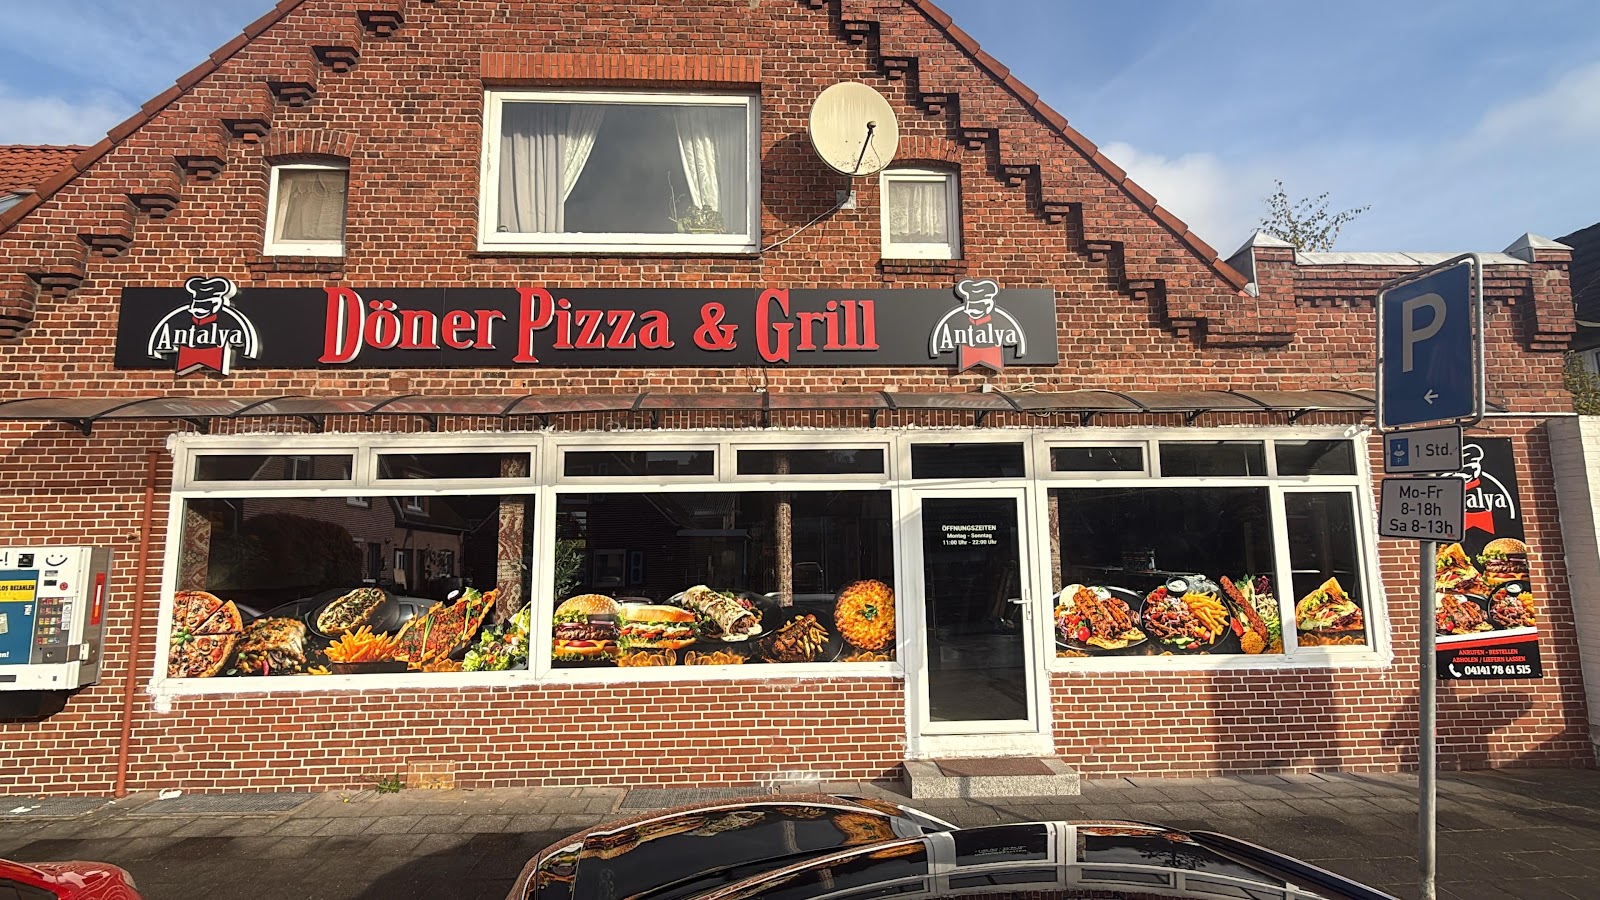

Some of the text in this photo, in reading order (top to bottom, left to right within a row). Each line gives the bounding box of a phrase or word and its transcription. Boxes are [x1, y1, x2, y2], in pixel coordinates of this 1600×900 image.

[317, 285, 880, 364] Döner Pizza & Grill
[157, 322, 244, 351] Antalya
[940, 321, 1019, 349] Antalya
[1402, 292, 1447, 373] P
[1415, 442, 1453, 458] 1 Std.
[1399, 485, 1443, 499] Mo-Fr
[1401, 502, 1442, 516] 8-18h
[1389, 519, 1453, 534] Sa 8-13h
[1506, 655, 1526, 663] LASSEN
[1464, 665, 1532, 675] 04141 78 61 515
